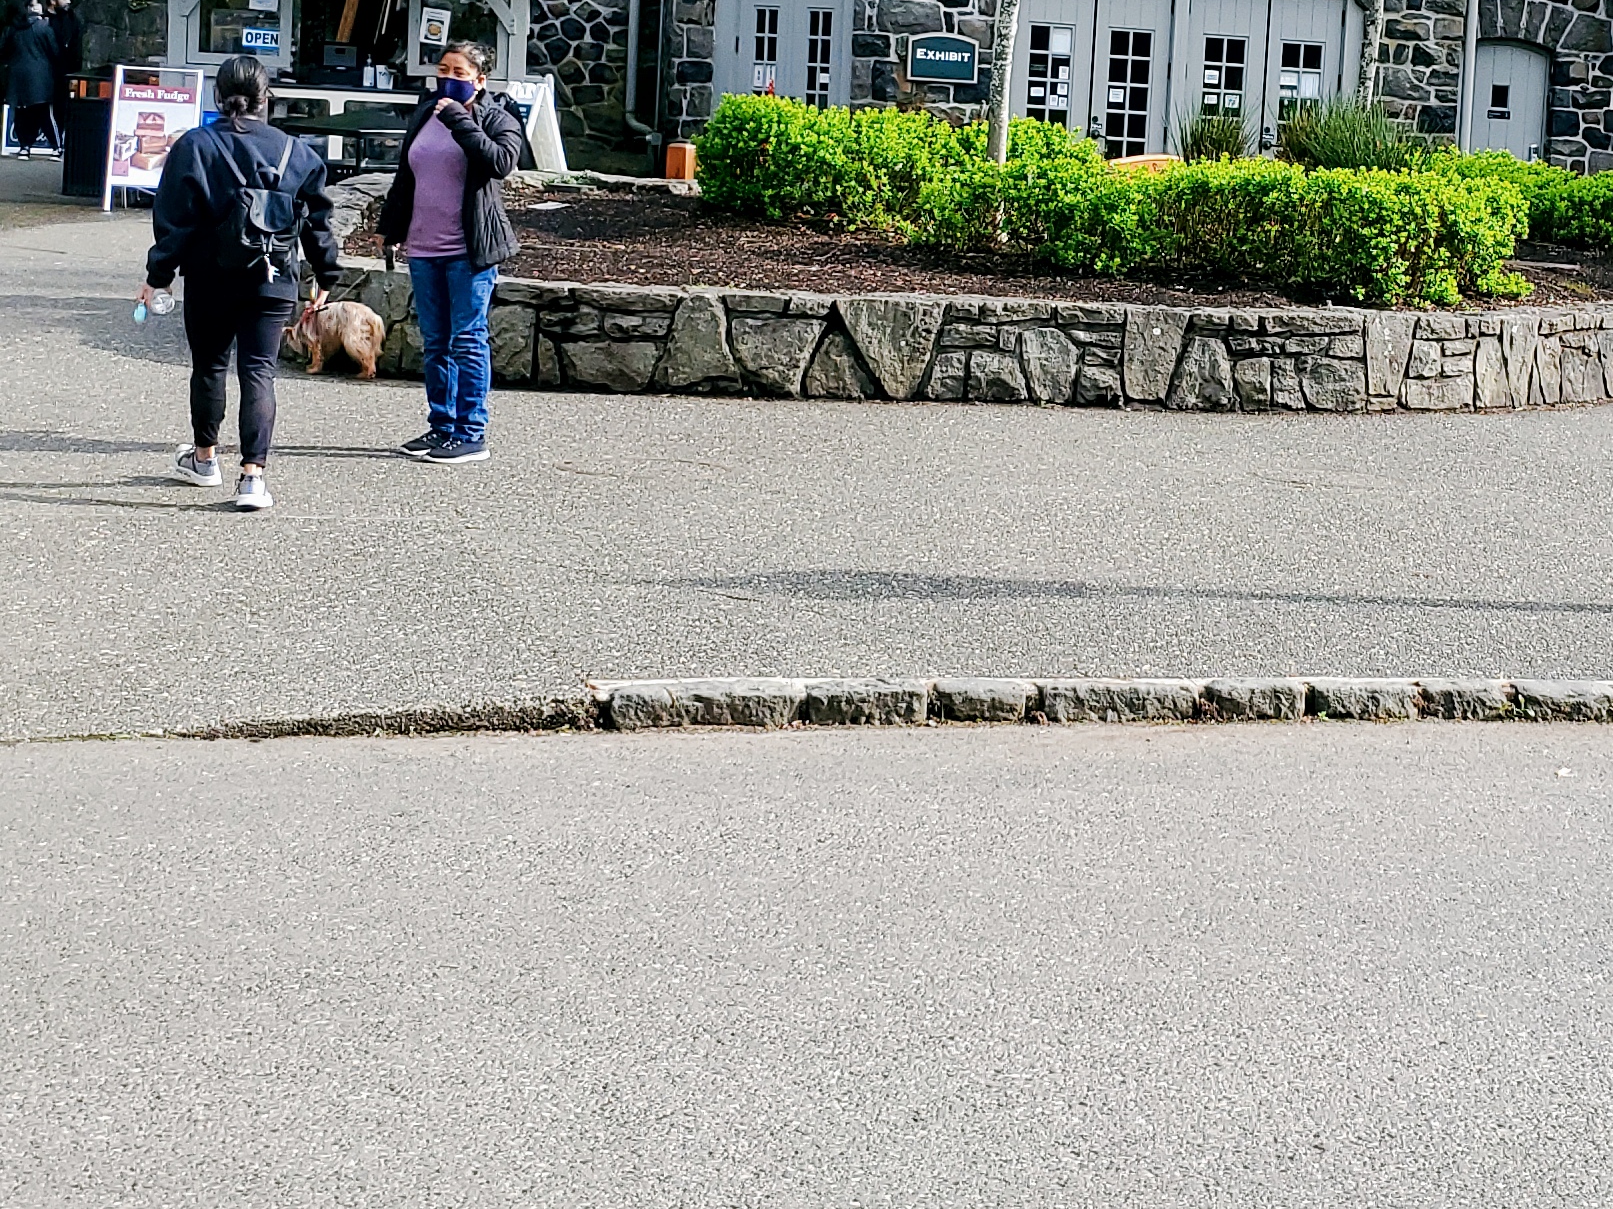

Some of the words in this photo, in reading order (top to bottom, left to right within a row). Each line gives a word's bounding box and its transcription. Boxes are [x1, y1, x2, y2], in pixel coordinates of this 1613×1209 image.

[245, 31, 279, 45] OPEN
[916, 48, 971, 62] EXHIBIT
[125, 88, 155, 99] Fresh
[157, 90, 190, 103] Fudge
